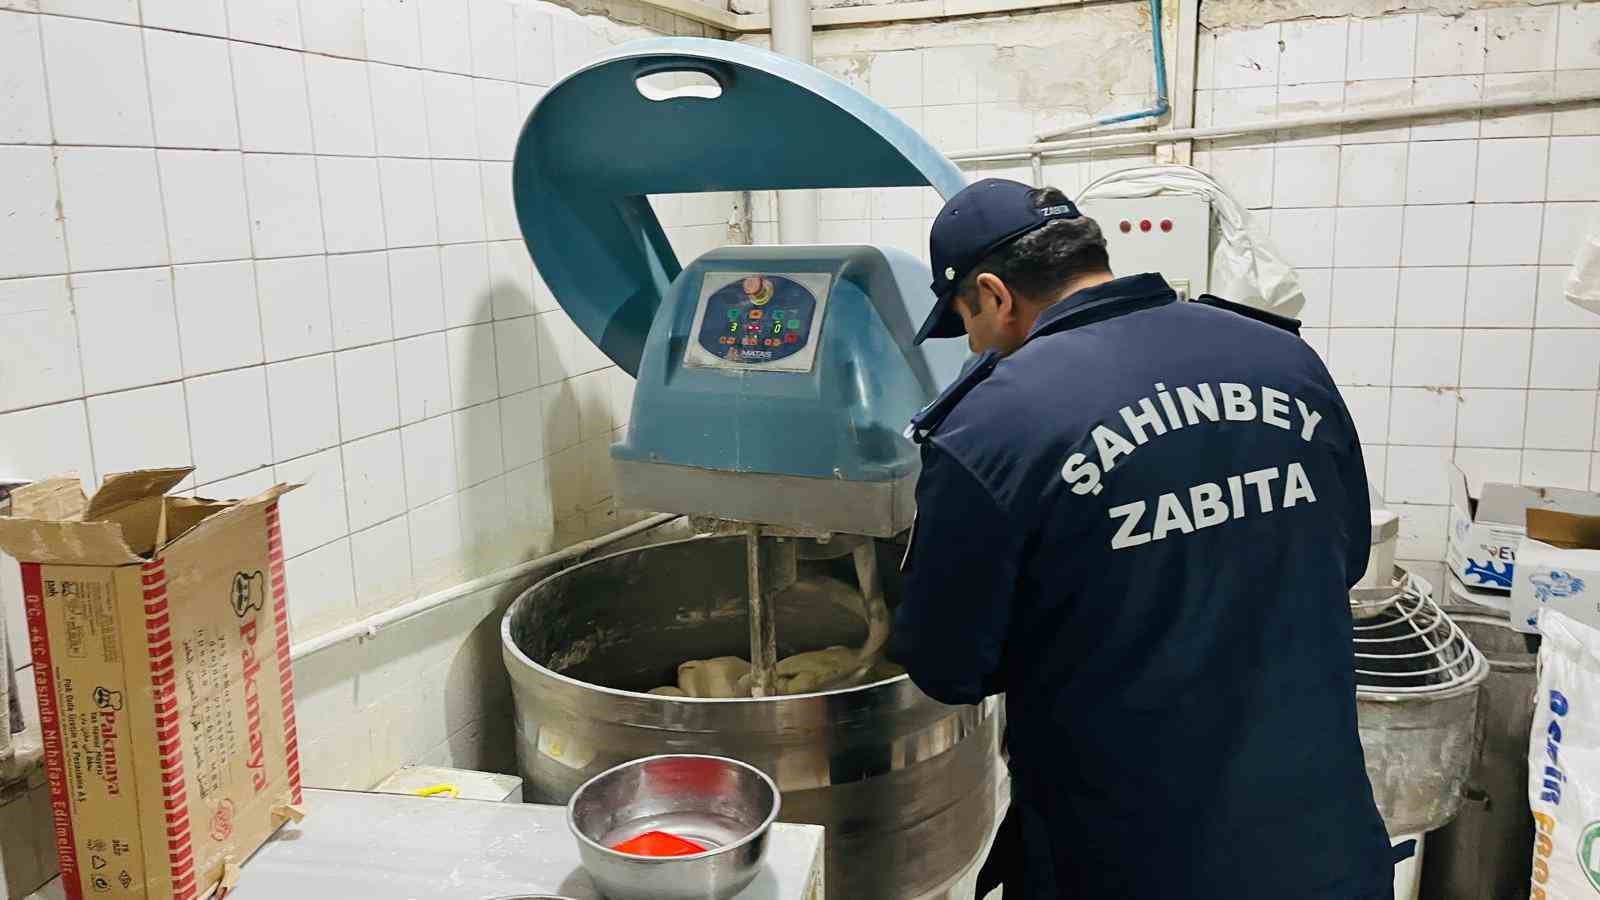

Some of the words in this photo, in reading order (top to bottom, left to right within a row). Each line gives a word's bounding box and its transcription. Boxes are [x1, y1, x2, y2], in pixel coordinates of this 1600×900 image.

[1061, 382, 1323, 496] ŞAHİNBEY
[1109, 462, 1318, 550] ZABITA
[239, 618, 268, 793] Pakmaya
[44, 730, 63, 795] Muhafaza
[100, 710, 121, 797] Pakmaya
